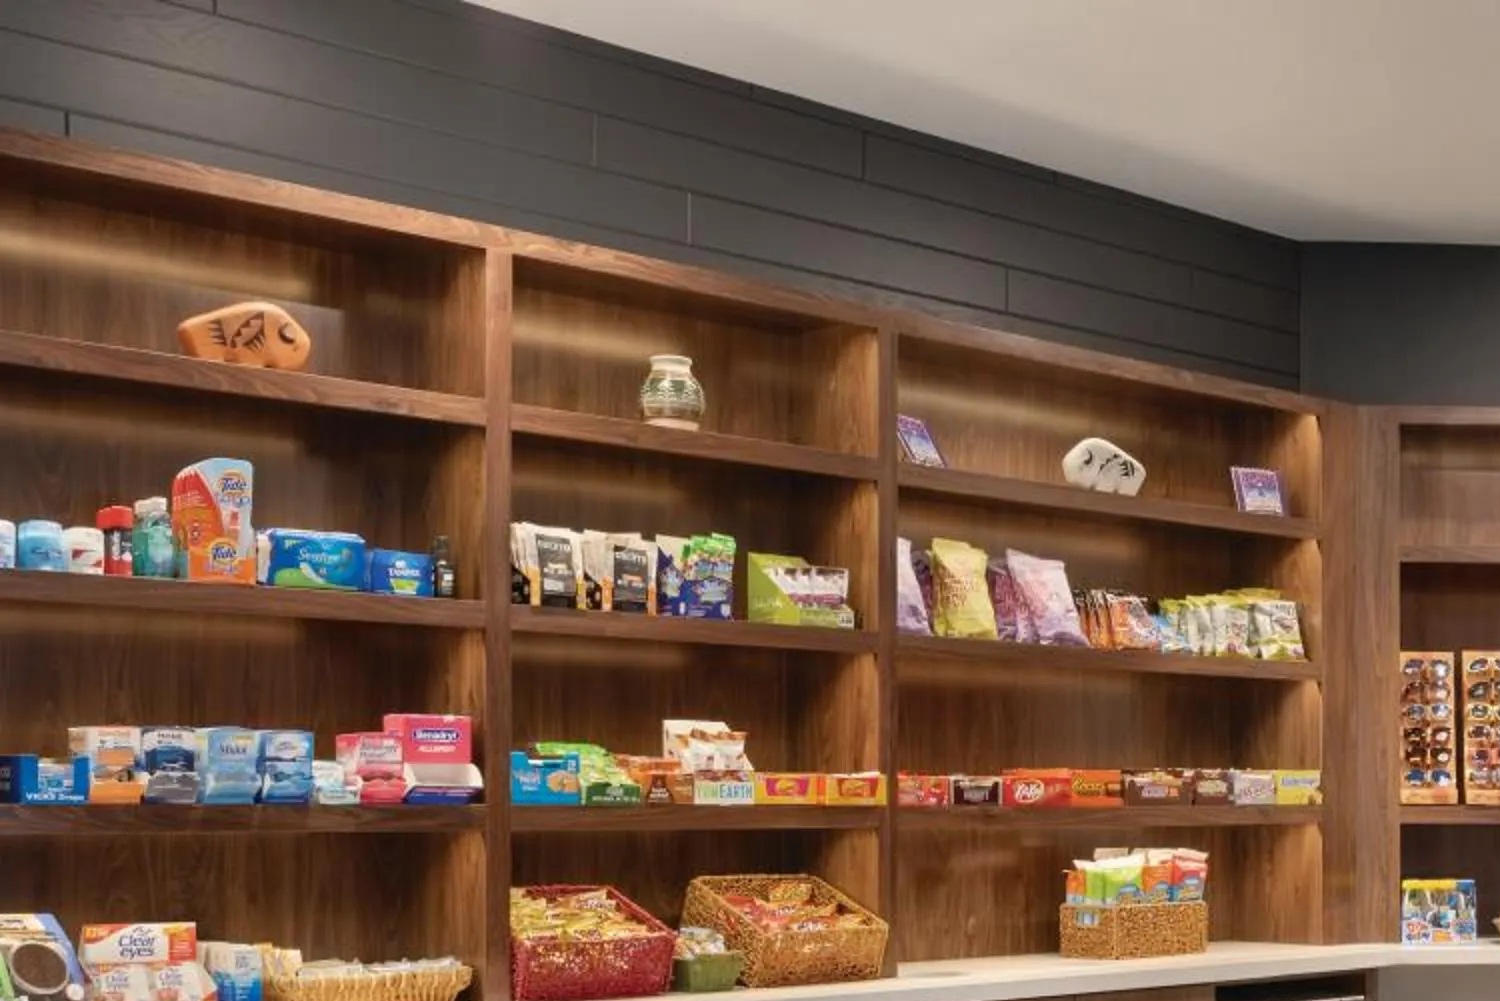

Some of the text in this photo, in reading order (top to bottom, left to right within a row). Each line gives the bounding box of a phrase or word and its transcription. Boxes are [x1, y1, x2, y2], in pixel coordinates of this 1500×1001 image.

[720, 783, 753, 799] EARTH
[119, 934, 155, 947] Clear
[119, 947, 155, 960] eyes
